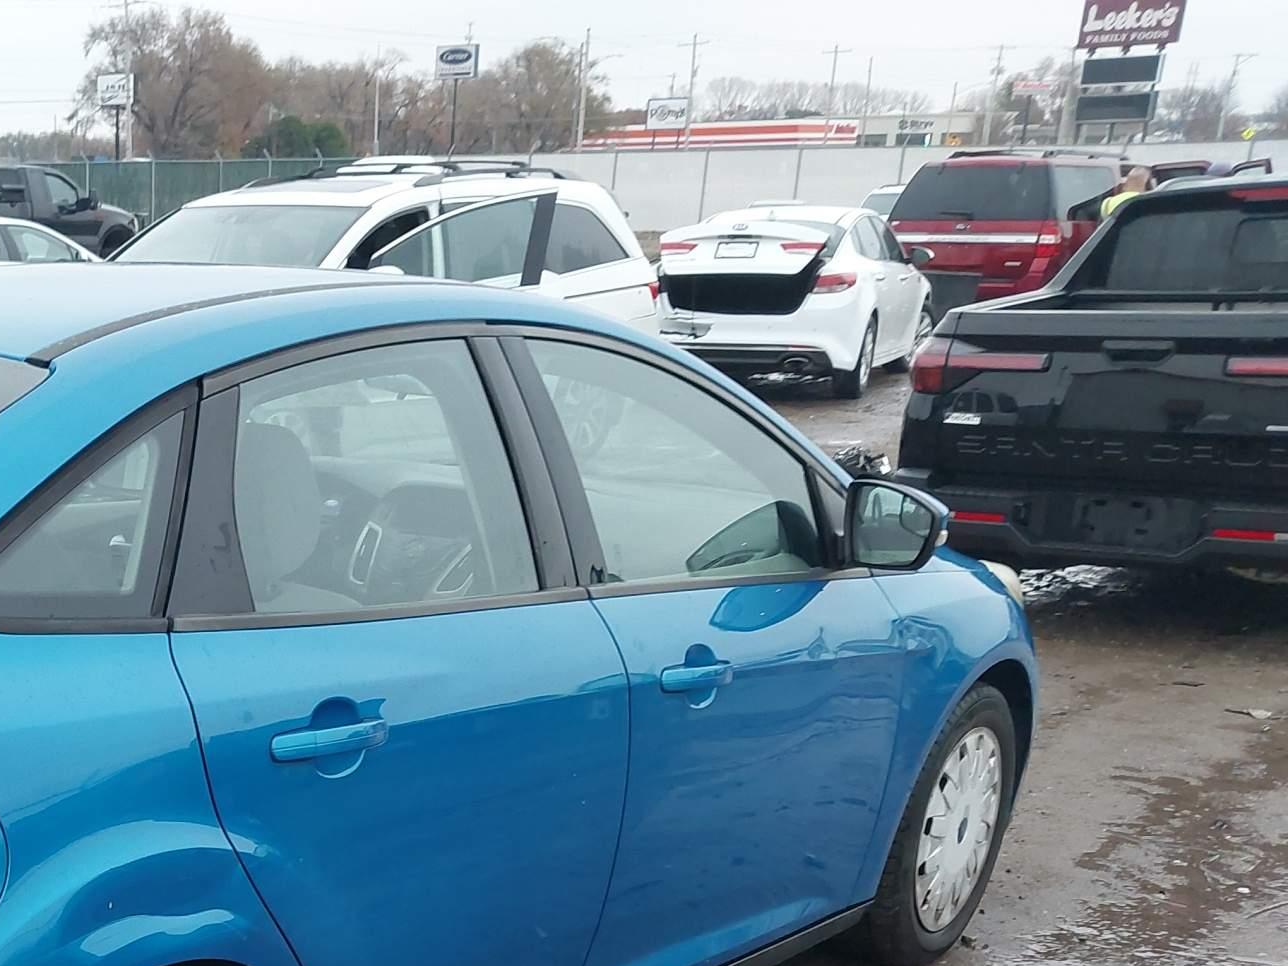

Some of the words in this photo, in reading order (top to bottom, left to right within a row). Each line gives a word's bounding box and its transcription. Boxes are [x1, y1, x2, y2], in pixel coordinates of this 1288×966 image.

[1082, 1, 1180, 32] Leeker's
[1084, 32, 1129, 44] FAMILY
[1129, 29, 1170, 41] FOODS
[956, 435, 1129, 461] SANTA
